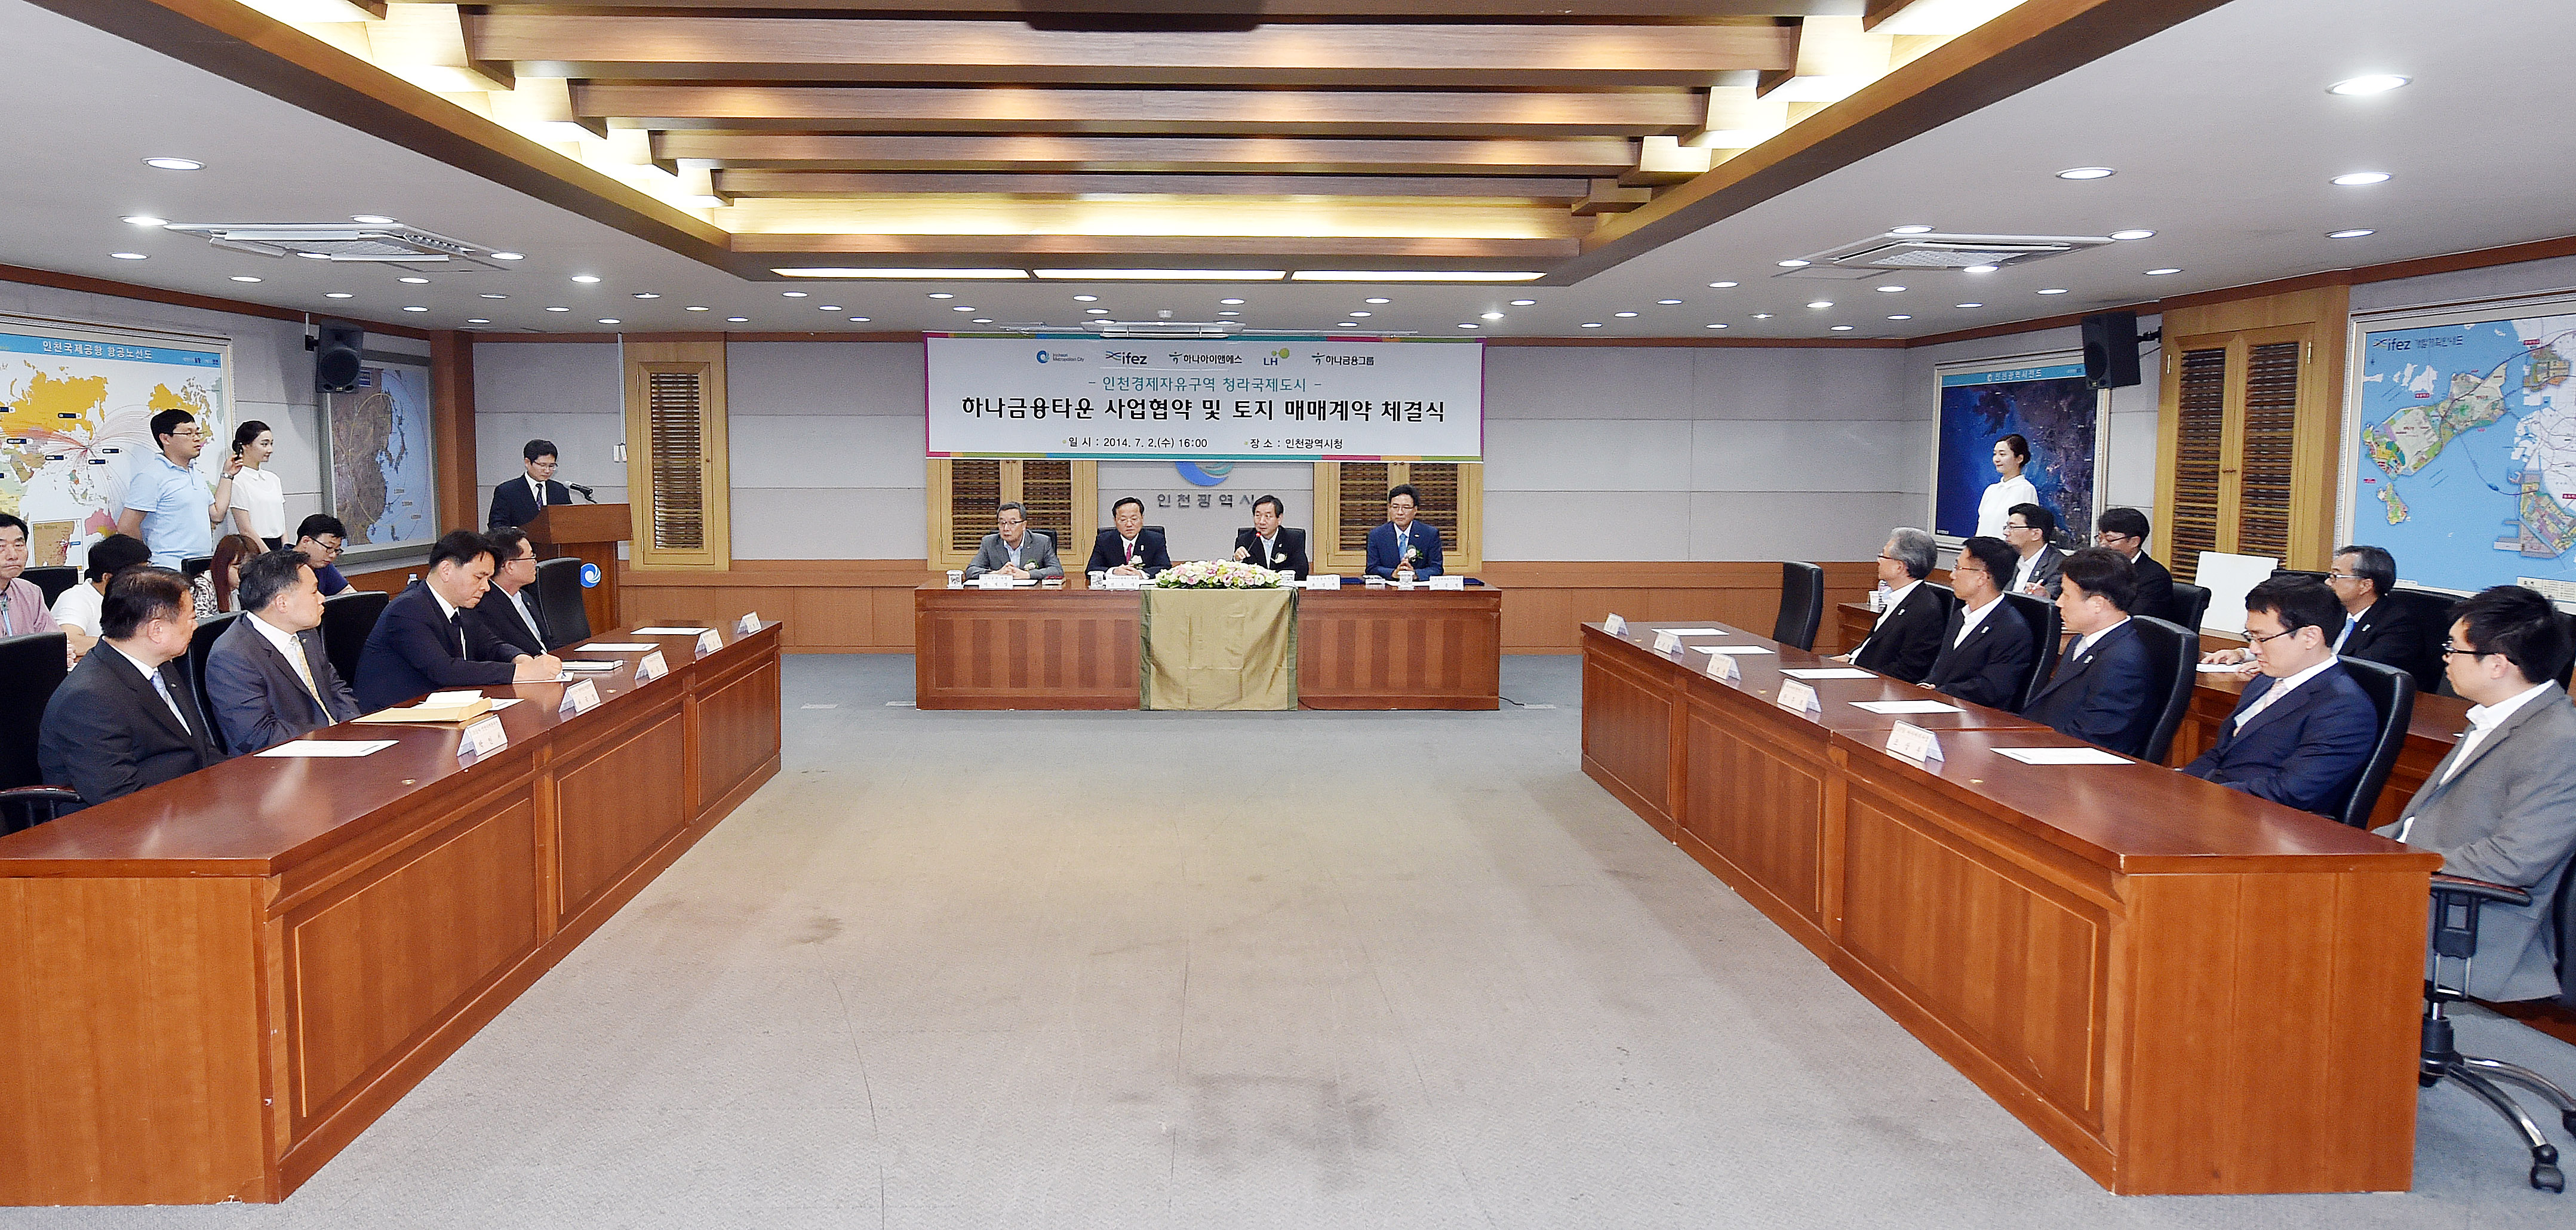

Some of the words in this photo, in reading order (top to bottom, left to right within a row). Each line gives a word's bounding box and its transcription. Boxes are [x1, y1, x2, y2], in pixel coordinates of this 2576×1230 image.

[42, 341, 103, 356] 인천국제공항
[107, 346, 153, 359] 항공노선도
[2389, 338, 2411, 351] ifez
[1122, 352, 1148, 365] ifez
[1184, 353, 1243, 365] 하나아이앤에스
[1263, 358, 1278, 366] LH
[1326, 355, 1375, 366] 하나금융그룹
[1102, 376, 1215, 392] 인천경제자유구역
[1222, 377, 1307, 392] 청라국제도시
[962, 397, 1095, 419] 하나금융타운
[1105, 398, 1192, 420] 사업협약
[1202, 399, 1221, 420] 및
[1232, 399, 1273, 420] 토지
[1285, 400, 1372, 422] 매매계약
[1381, 401, 1444, 422] 체결식
[1103, 438, 1131, 447] 2014.
[1135, 438, 1144, 448] 7.
[1148, 438, 1175, 448] 2.(수)
[1179, 438, 1208, 448] 16:00
[1285, 439, 1343, 449] 인천광역시청
[1157, 493, 1254, 508] 인천광역시
